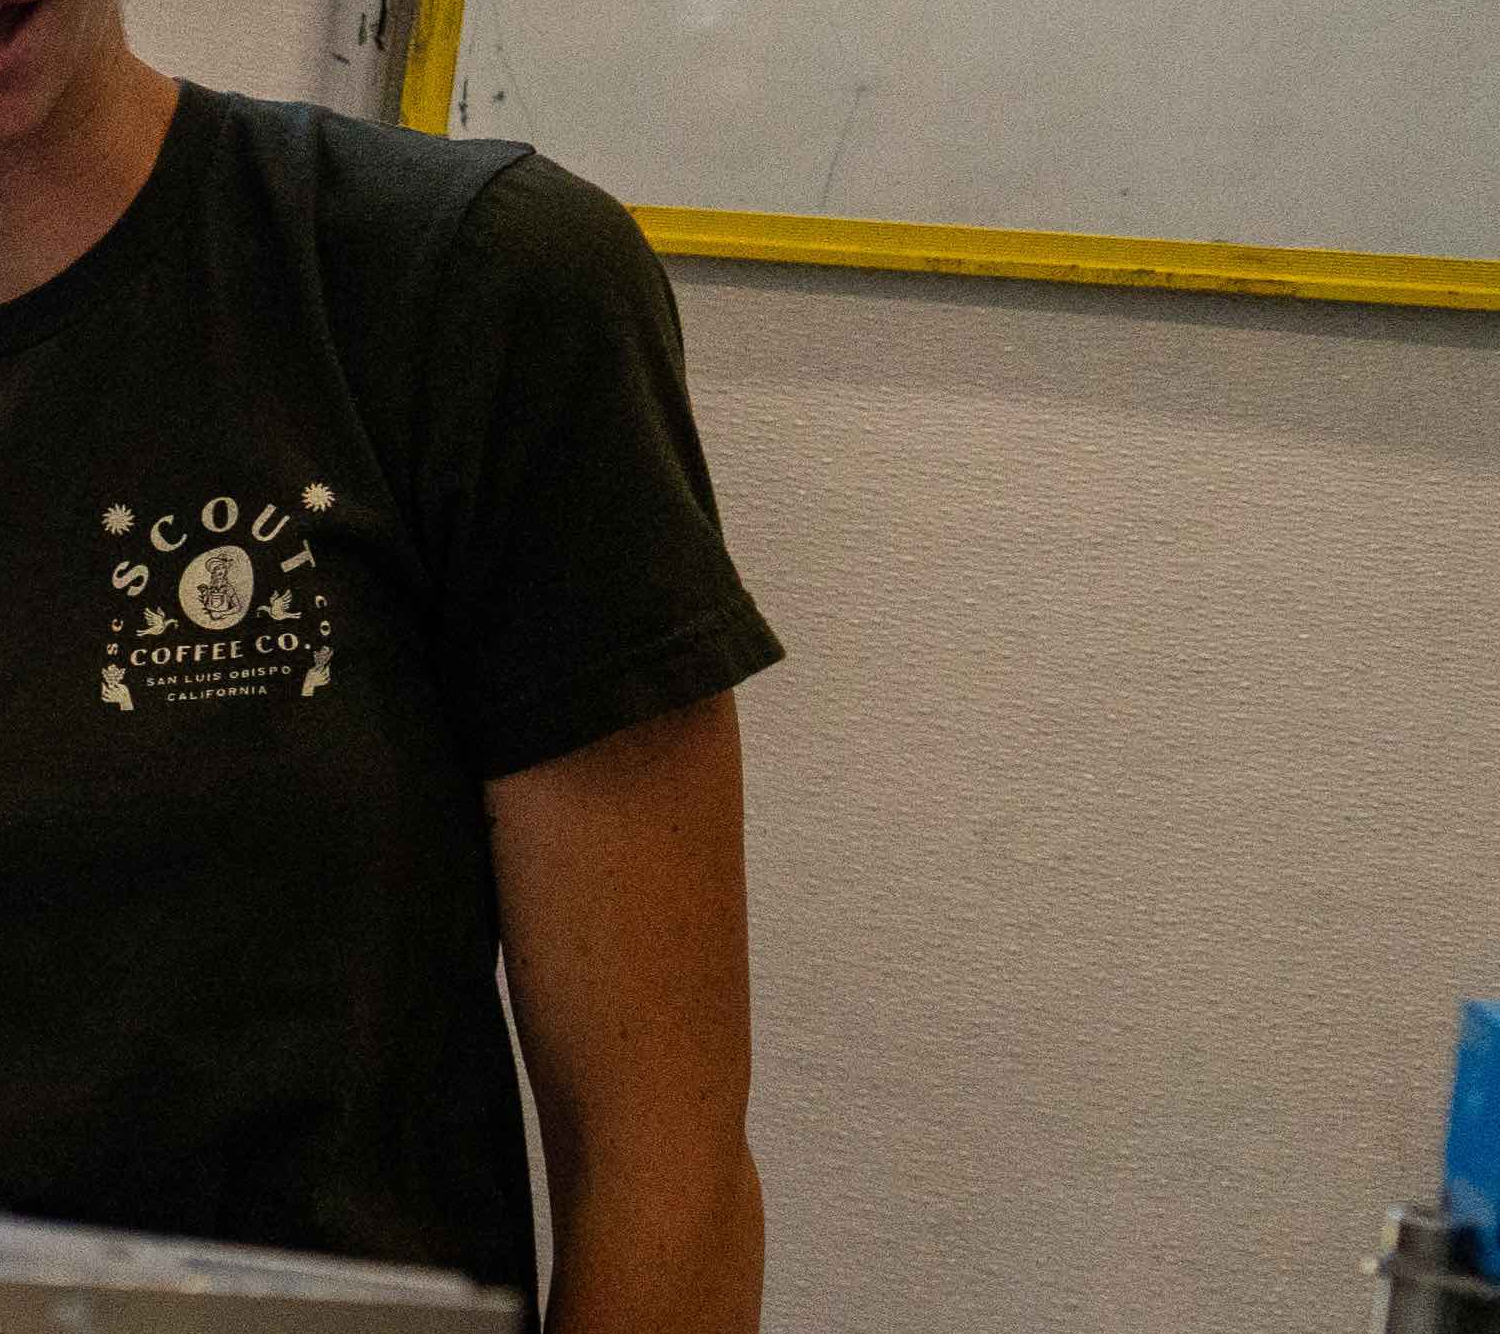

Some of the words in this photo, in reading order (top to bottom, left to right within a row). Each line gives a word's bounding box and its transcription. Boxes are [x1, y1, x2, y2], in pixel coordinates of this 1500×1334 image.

[111, 496, 317, 597] SCOUT
[130, 640, 244, 667] COFFEE
[255, 632, 312, 655] CO.
[146, 674, 178, 687] SAN
[184, 672, 222, 684] LUIS
[228, 665, 292, 680] OBISPO
[167, 684, 269, 702] CALIFORNIA
